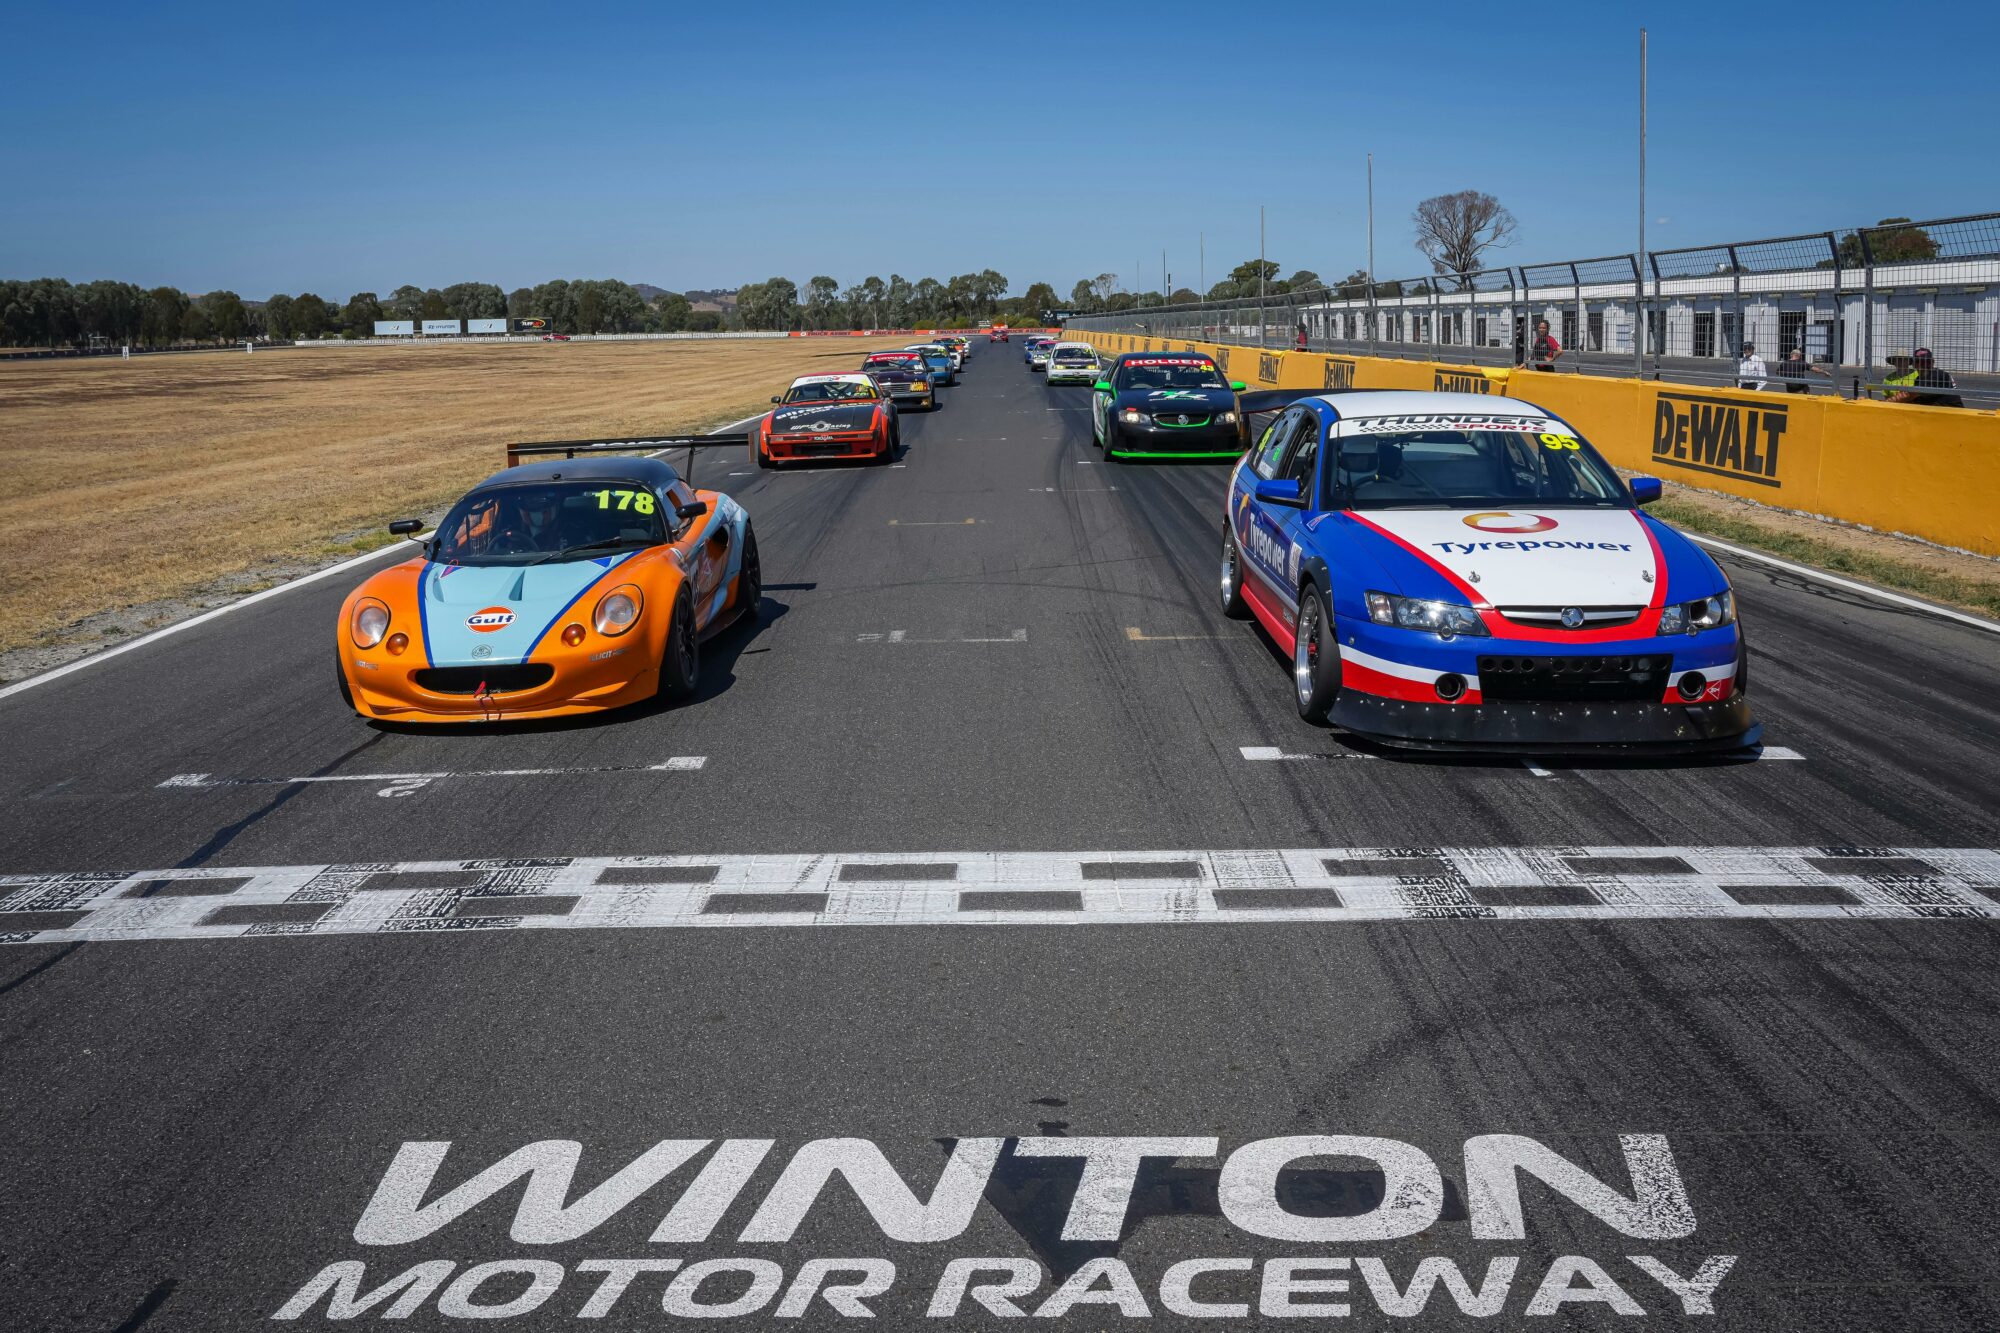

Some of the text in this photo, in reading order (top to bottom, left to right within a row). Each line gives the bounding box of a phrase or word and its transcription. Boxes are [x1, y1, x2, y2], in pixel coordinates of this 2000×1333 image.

[1353, 416, 1547, 427] THUNDER
[1454, 424, 1546, 432] SPORTS
[1540, 433, 1580, 450] 95
[595, 490, 654, 514] 178
[1250, 513, 1285, 577] Tyrepower
[1432, 541, 1632, 554] Tyrepower
[468, 614, 514, 624] Gulf
[353, 1133, 1697, 1245] WINTON
[270, 1255, 1739, 1320] MOTOR RACEWAY
